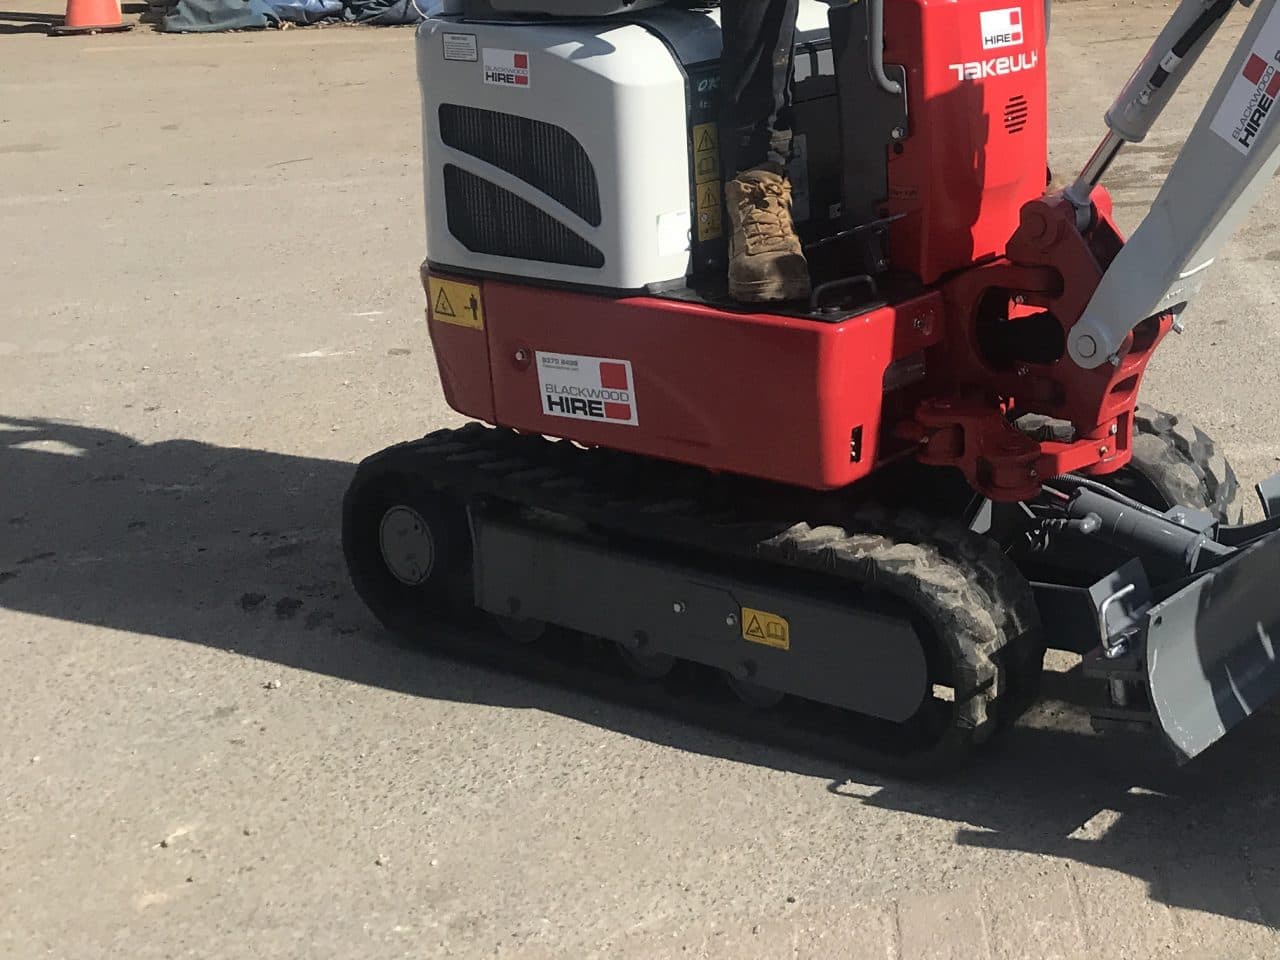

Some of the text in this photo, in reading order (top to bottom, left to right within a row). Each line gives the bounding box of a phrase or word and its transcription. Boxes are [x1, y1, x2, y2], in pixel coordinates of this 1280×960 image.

[984, 33, 1011, 46] HIRE
[485, 71, 515, 84] HIRE
[1232, 66, 1275, 140] BLACKWOOD
[1238, 94, 1274, 149] HIRE
[545, 383, 630, 402] BLACKWOOD
[546, 394, 604, 418] HIRE
